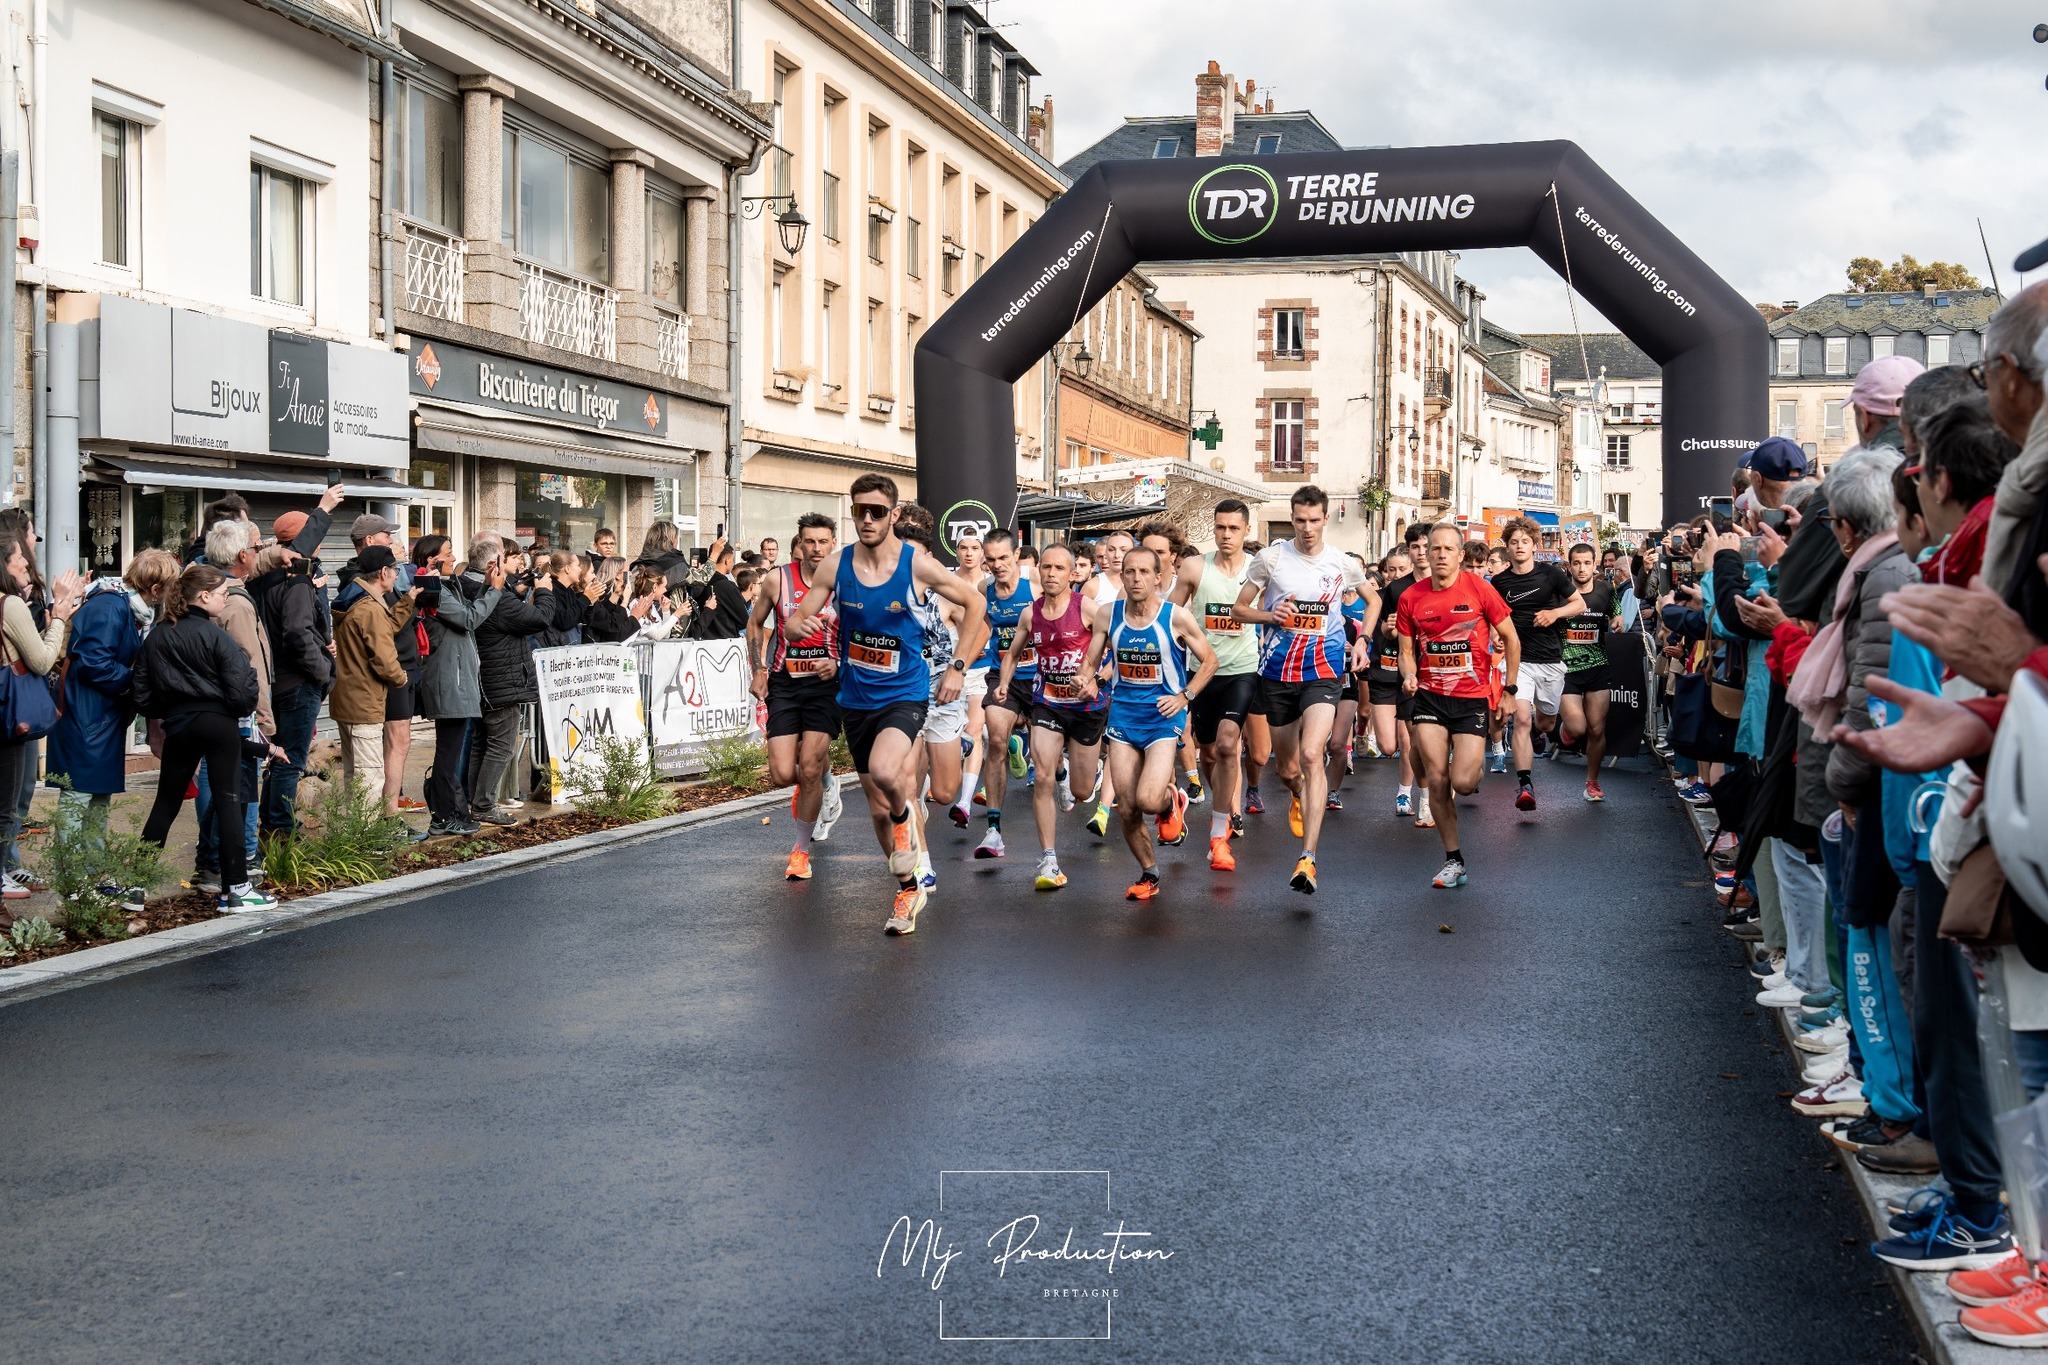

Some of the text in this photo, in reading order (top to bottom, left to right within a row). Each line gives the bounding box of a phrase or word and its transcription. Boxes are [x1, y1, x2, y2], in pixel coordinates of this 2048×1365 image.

[1287, 172, 1379, 199] TERRE
[1203, 188, 1267, 220] TDR
[1298, 194, 1475, 226] DE RUNNING
[1574, 206, 1697, 317] terrederunning.com
[981, 230, 1096, 342] terrederunning.com
[278, 360, 291, 389] Ti
[210, 379, 261, 418] Bijoux
[278, 377, 325, 427] Anaë
[480, 362, 556, 410] Biscuiterie
[559, 379, 577, 414] du
[579, 384, 620, 429] Trégor
[333, 399, 378, 419] Accessoires
[333, 418, 369, 437] de mode
[1681, 438, 1761, 451] Chaussures
[1294, 616, 1317, 628] 973
[865, 635, 897, 648] endro
[1573, 632, 1594, 640] 1021
[861, 649, 886, 665] 792
[1440, 642, 1468, 653] endro
[1131, 653, 1158, 663] endro
[1438, 655, 1461, 667] 926
[1128, 666, 1150, 678] 769
[1853, 952, 1885, 1043] Best Sport
